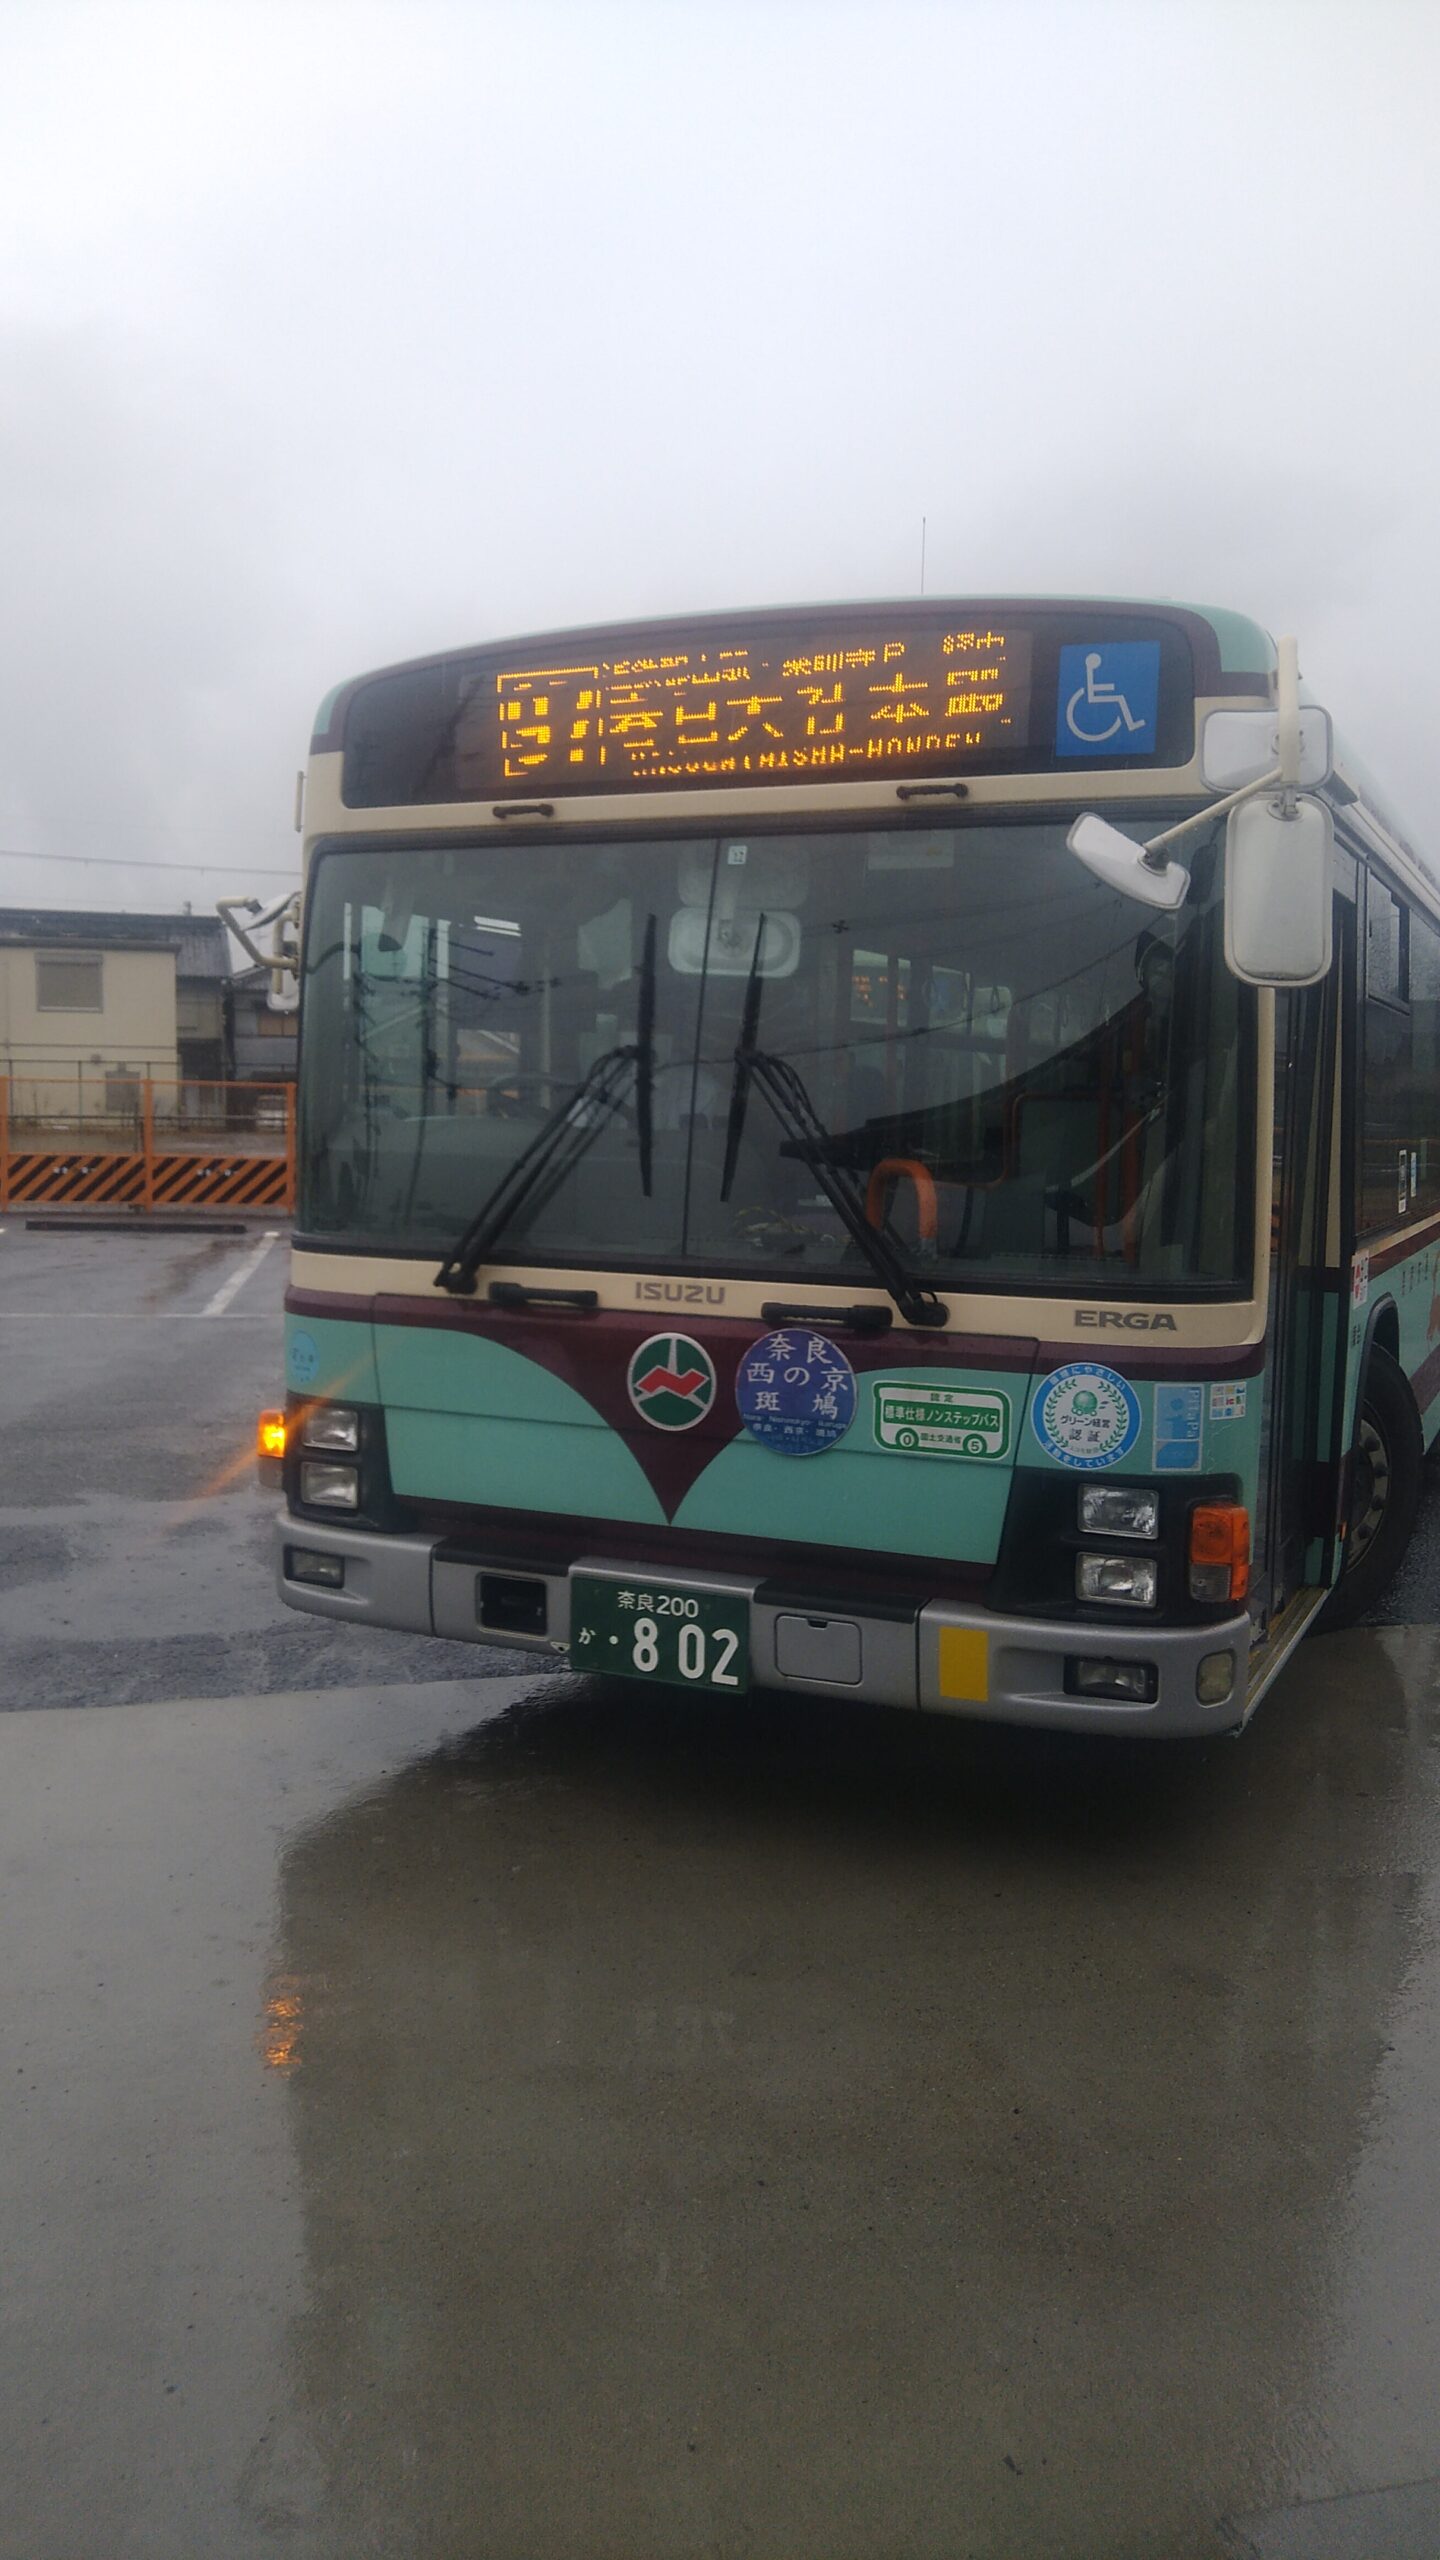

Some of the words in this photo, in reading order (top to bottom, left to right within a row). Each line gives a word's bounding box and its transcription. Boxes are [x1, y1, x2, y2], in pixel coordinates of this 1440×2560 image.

[635, 1281, 726, 1305] ISUZU
[1074, 1309, 1177, 1332] ERGA
[766, 1333, 833, 1364] 奈良
[747, 1362, 849, 1393] 西の京
[755, 1391, 839, 1420] 斑鳩
[970, 1441, 980, 1452] 5
[578, 1627, 596, 1645] か
